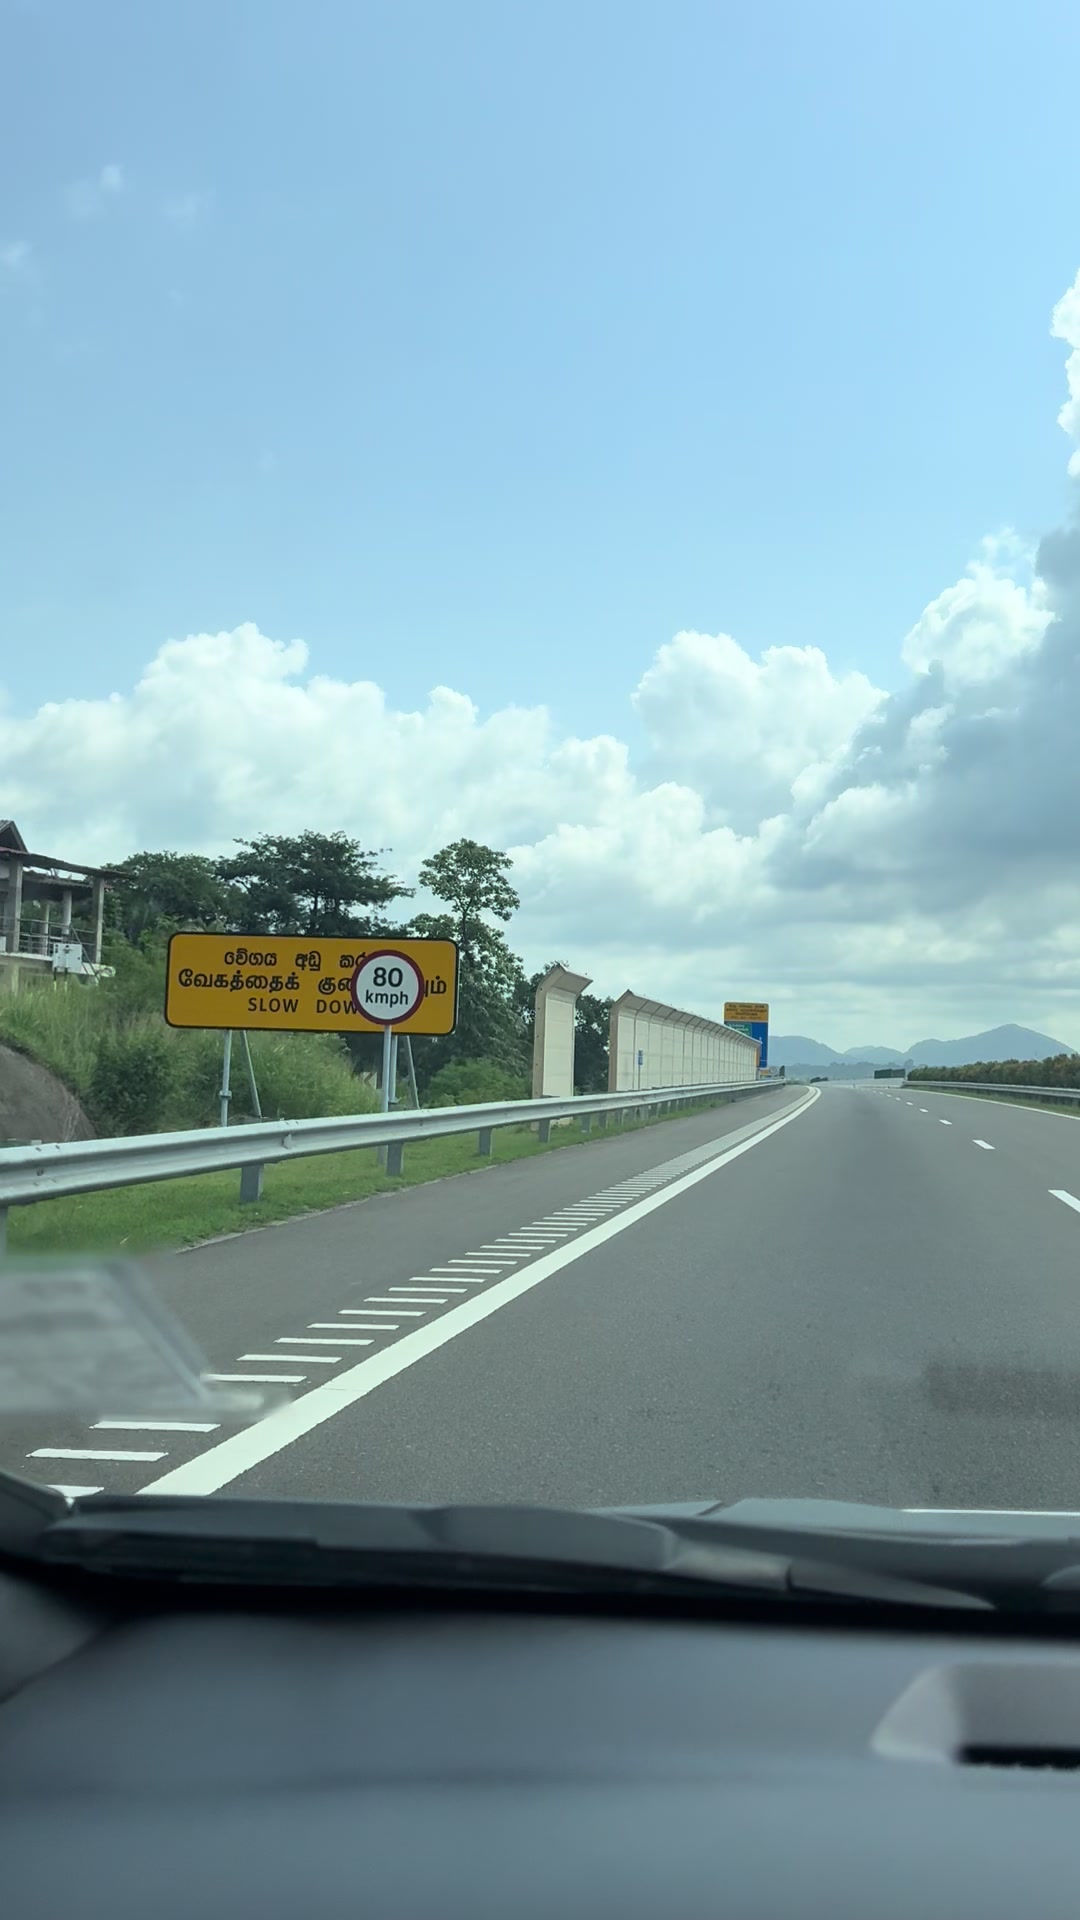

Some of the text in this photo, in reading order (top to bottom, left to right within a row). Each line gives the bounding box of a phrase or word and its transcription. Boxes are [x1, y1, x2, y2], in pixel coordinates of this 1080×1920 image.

[224, 947, 277, 967] වේගය
[295, 950, 322, 971] අඩු
[178, 968, 300, 993] வேகத்தைக்
[373, 967, 403, 988] 80
[248, 997, 357, 1015] SLOW DOW
[365, 989, 409, 1008] kmph
